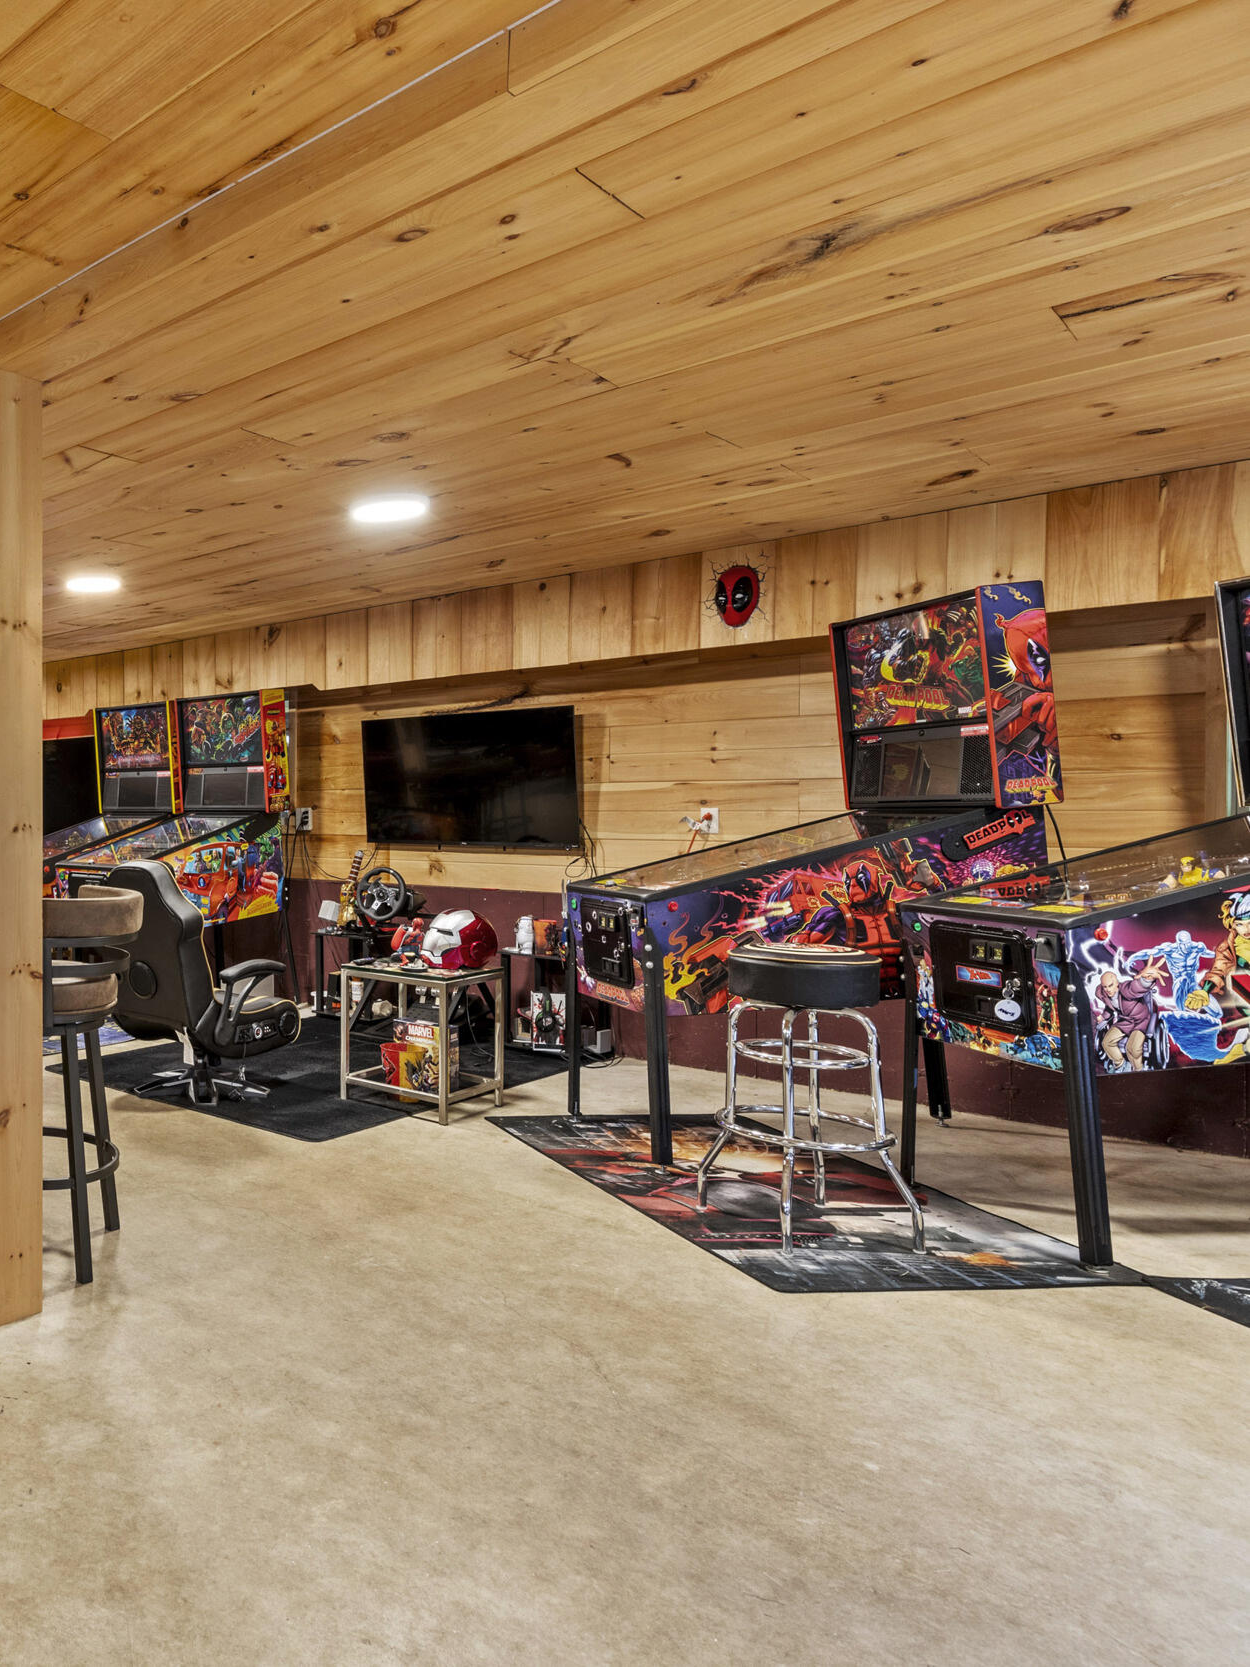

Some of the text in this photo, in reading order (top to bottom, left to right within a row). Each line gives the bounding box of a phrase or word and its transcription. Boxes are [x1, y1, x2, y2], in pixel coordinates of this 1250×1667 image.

[886, 684, 950, 711] DEADPOOL
[1005, 775, 1058, 793] DEADPOOL
[965, 810, 1031, 844] DEADPOOL
[408, 1024, 434, 1038] MARVEL
